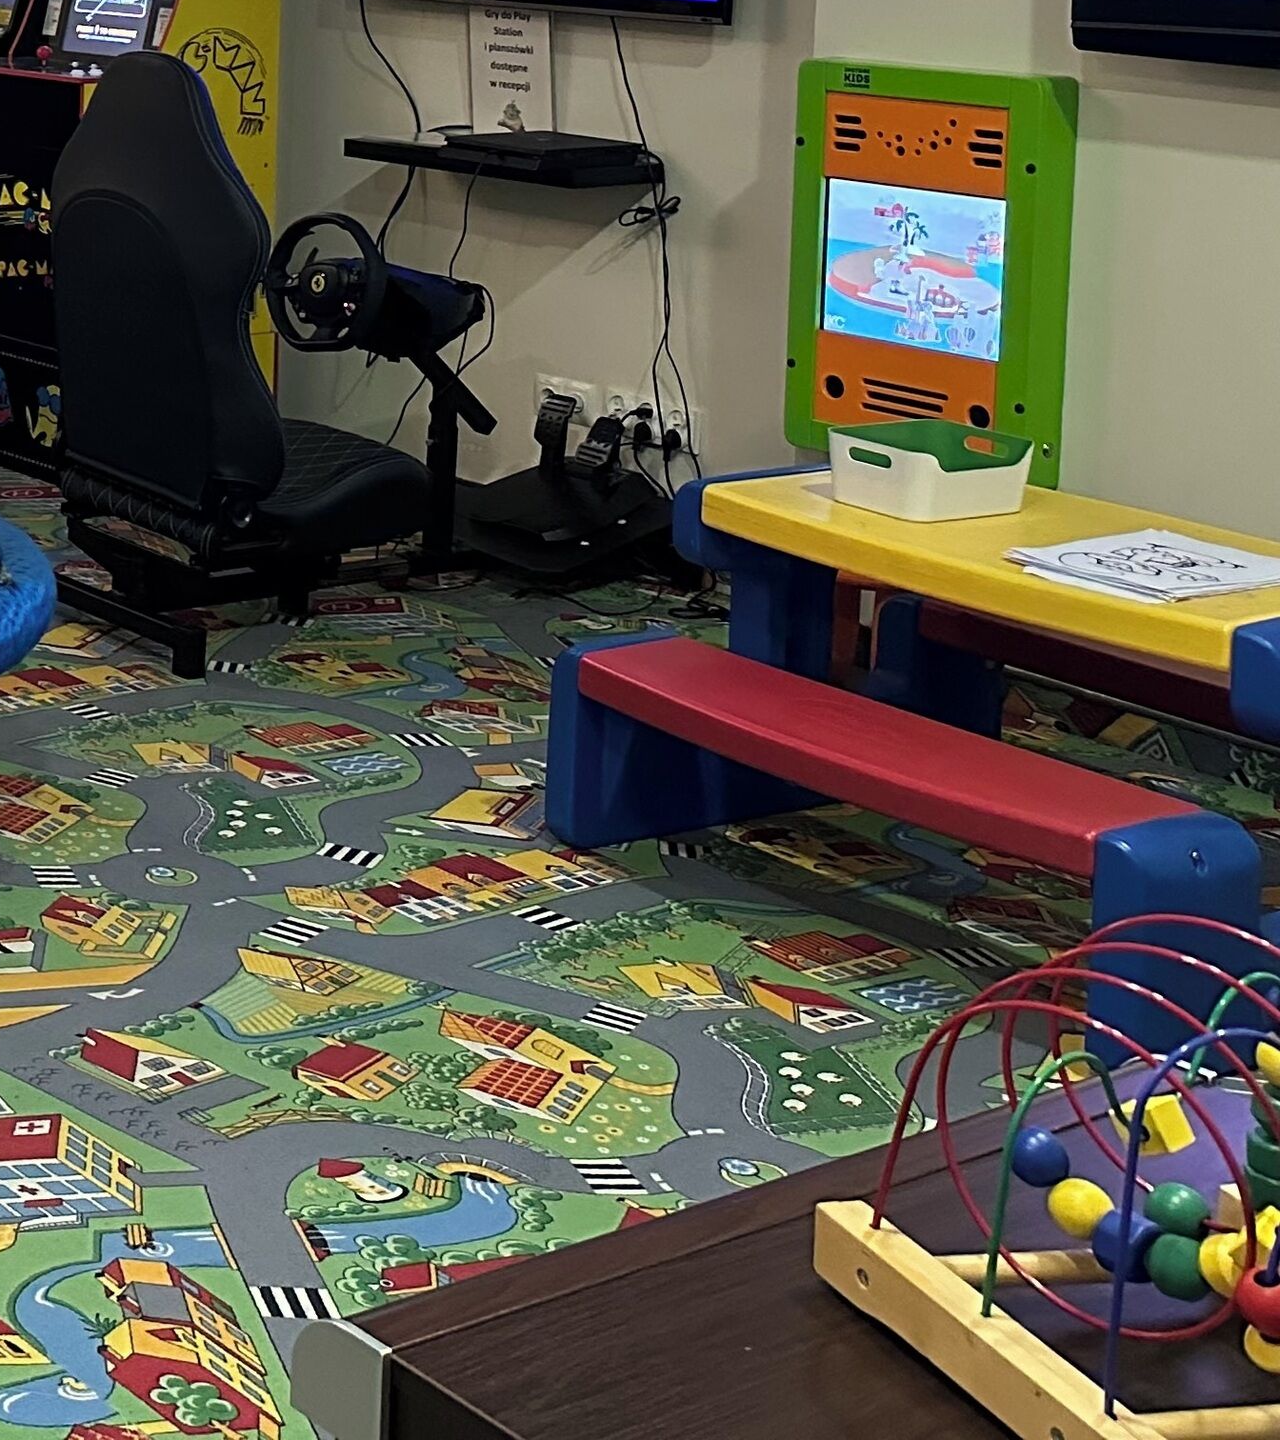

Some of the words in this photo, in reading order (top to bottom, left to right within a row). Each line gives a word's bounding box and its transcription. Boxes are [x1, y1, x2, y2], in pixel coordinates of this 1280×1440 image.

[484, 9, 499, 20] Gry
[501, 10, 512, 19] do
[513, 11, 531, 22] Play
[493, 26, 523, 37] Station
[489, 43, 534, 55] planszówki
[490, 61, 529, 73] dostępne
[844, 73, 870, 84] KIDS
[489, 80, 497, 88] w
[499, 81, 531, 92] recepcji
